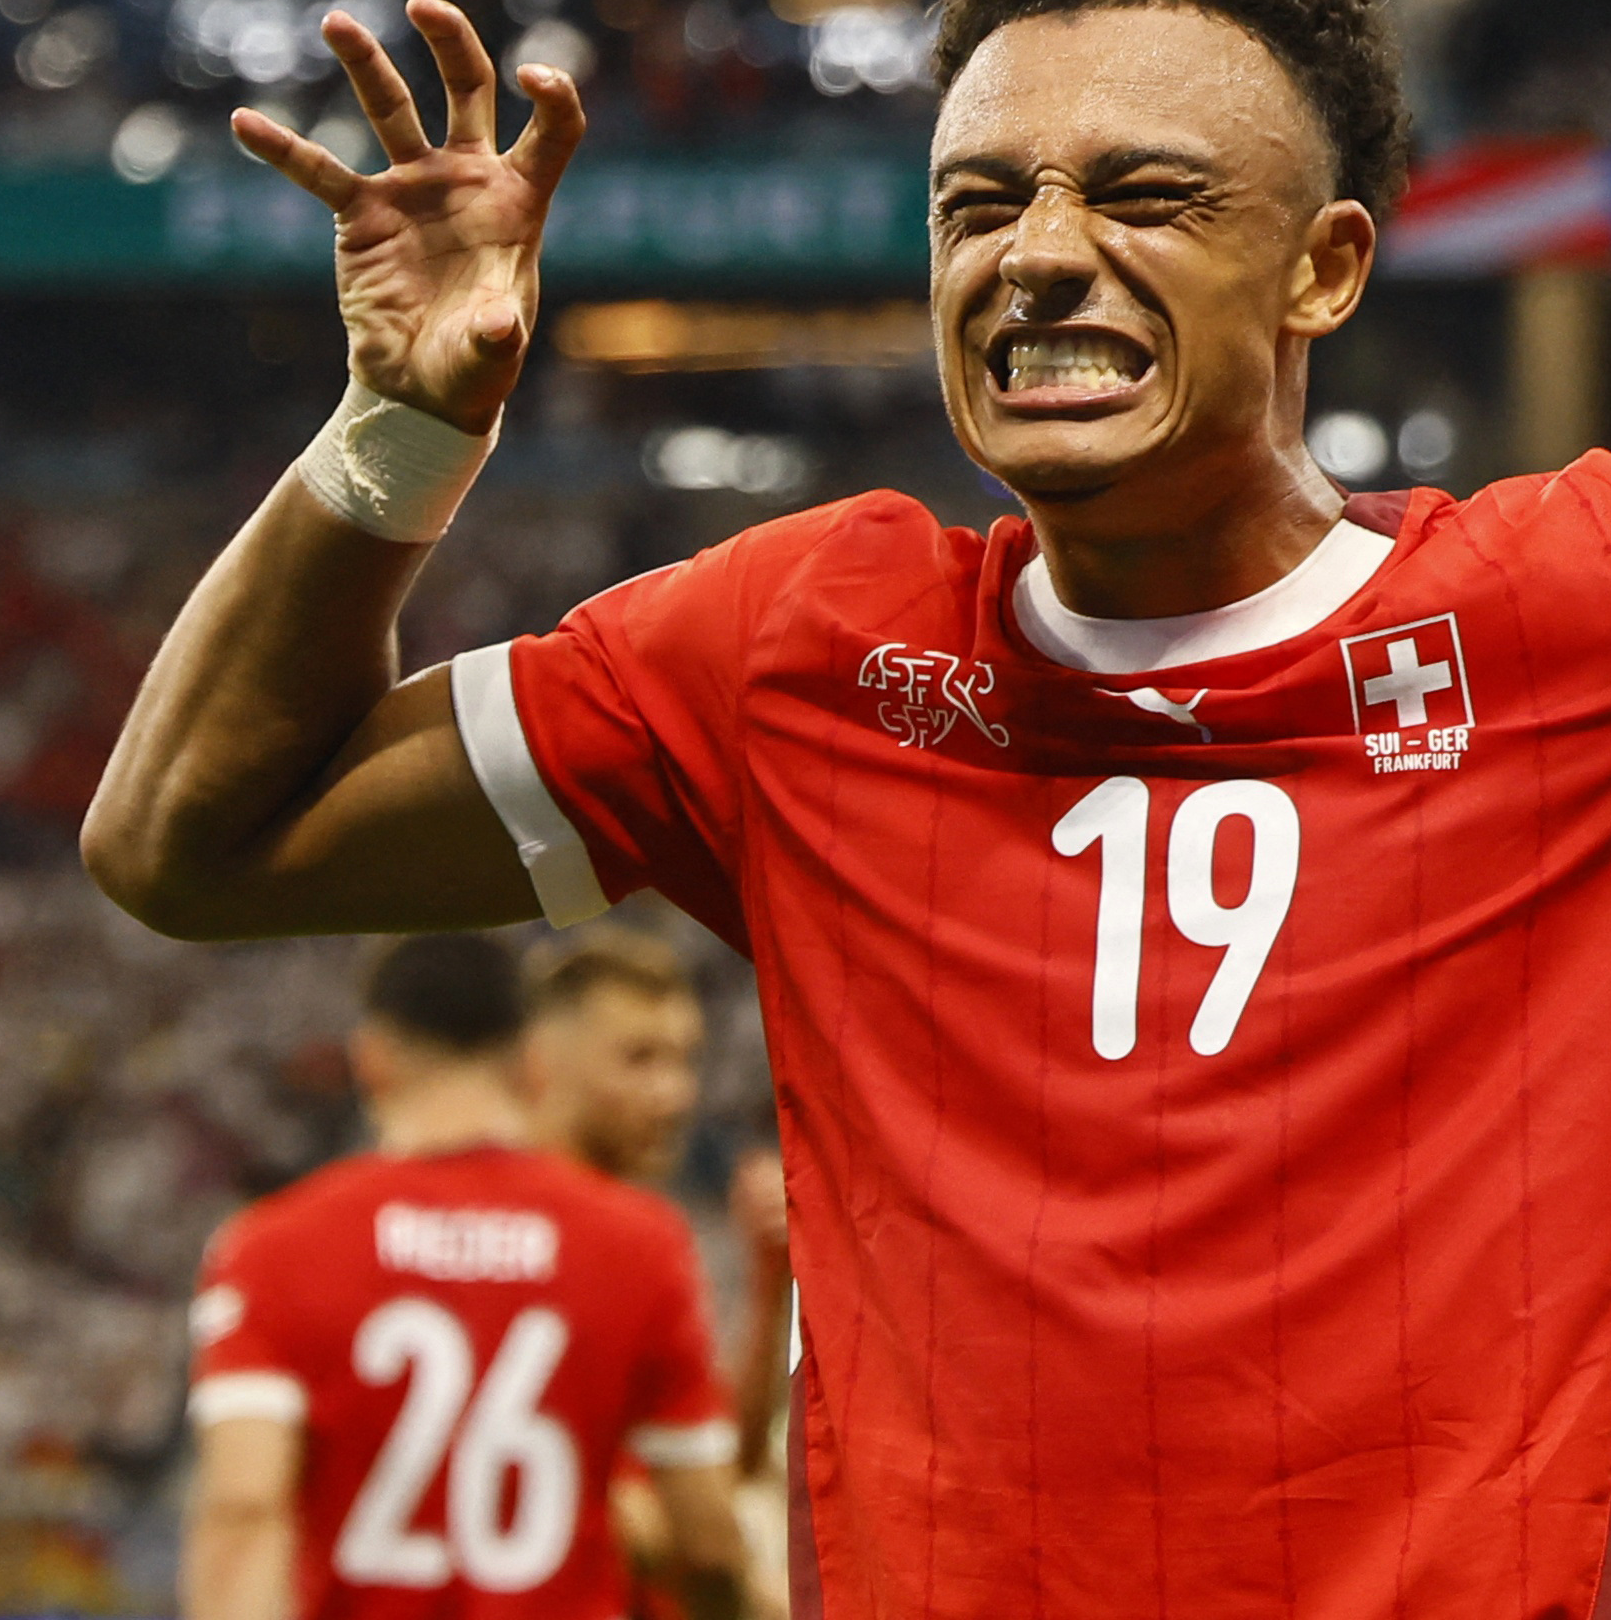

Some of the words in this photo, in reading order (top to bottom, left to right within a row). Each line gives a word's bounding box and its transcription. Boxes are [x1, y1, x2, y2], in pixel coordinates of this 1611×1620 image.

[1364, 732, 1400, 756] SUI
[1427, 729, 1469, 752] GER
[1374, 753, 1461, 774] FRANKFURT
[1052, 776, 1300, 1060] 19
[337, 1296, 579, 1592] 26
